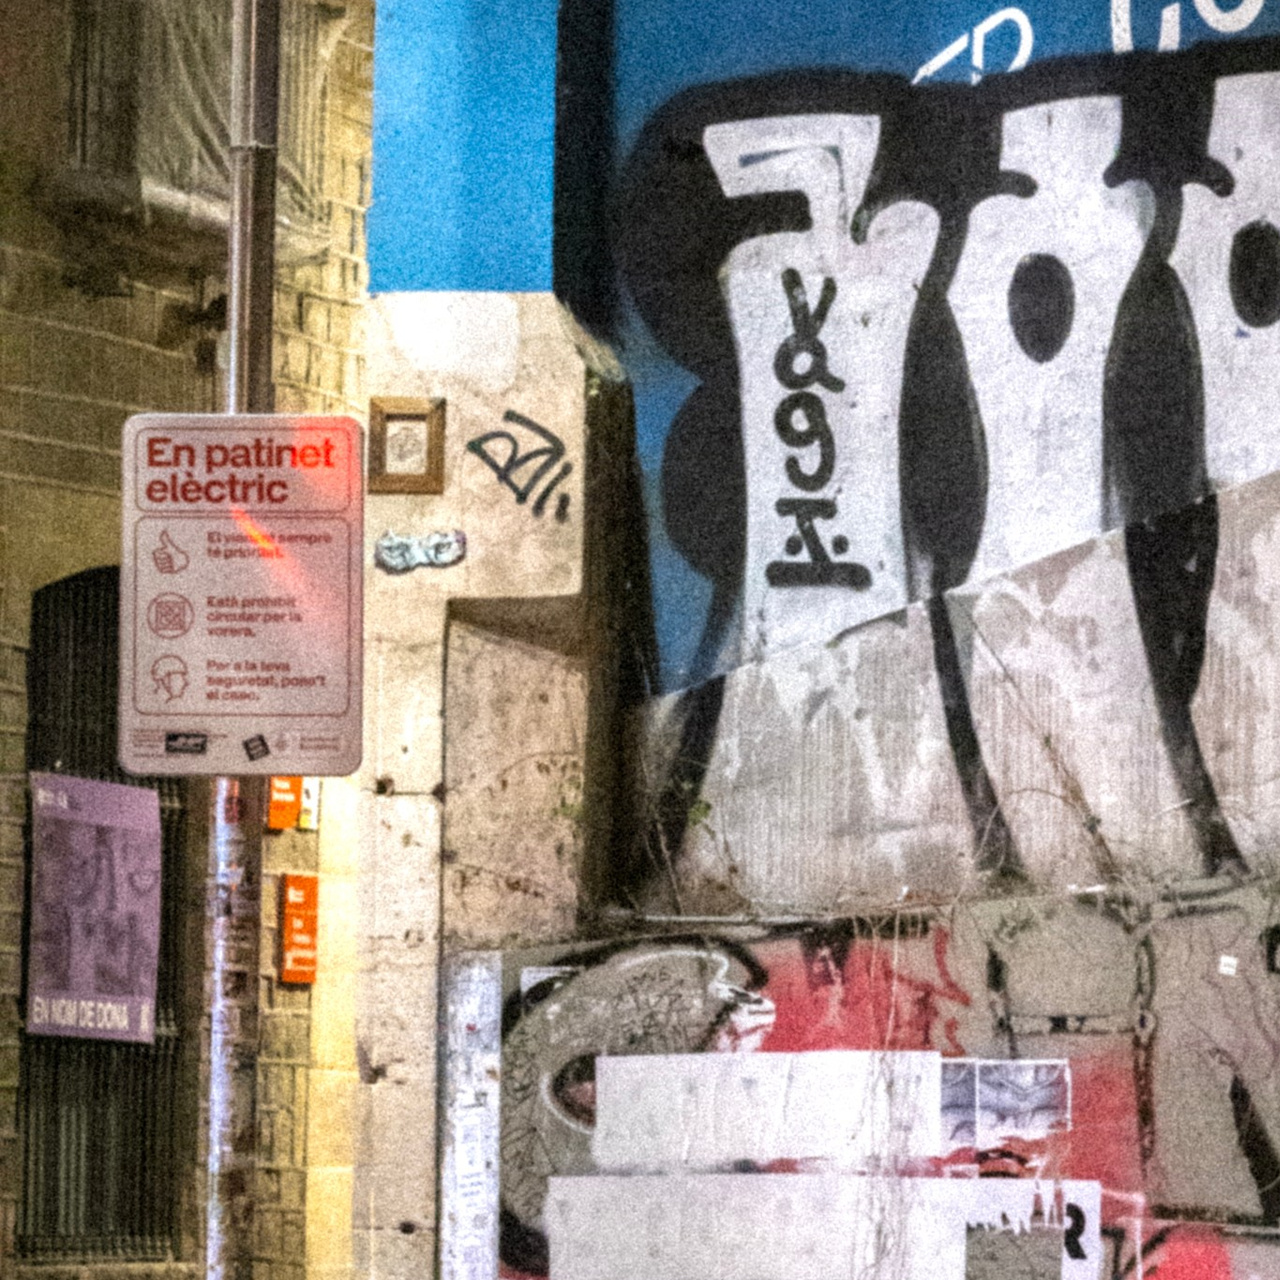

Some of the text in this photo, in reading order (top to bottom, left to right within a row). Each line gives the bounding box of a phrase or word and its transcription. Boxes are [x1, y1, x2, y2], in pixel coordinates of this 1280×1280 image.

[146, 436, 335, 473] En patinet
[146, 471, 289, 504] elèctric
